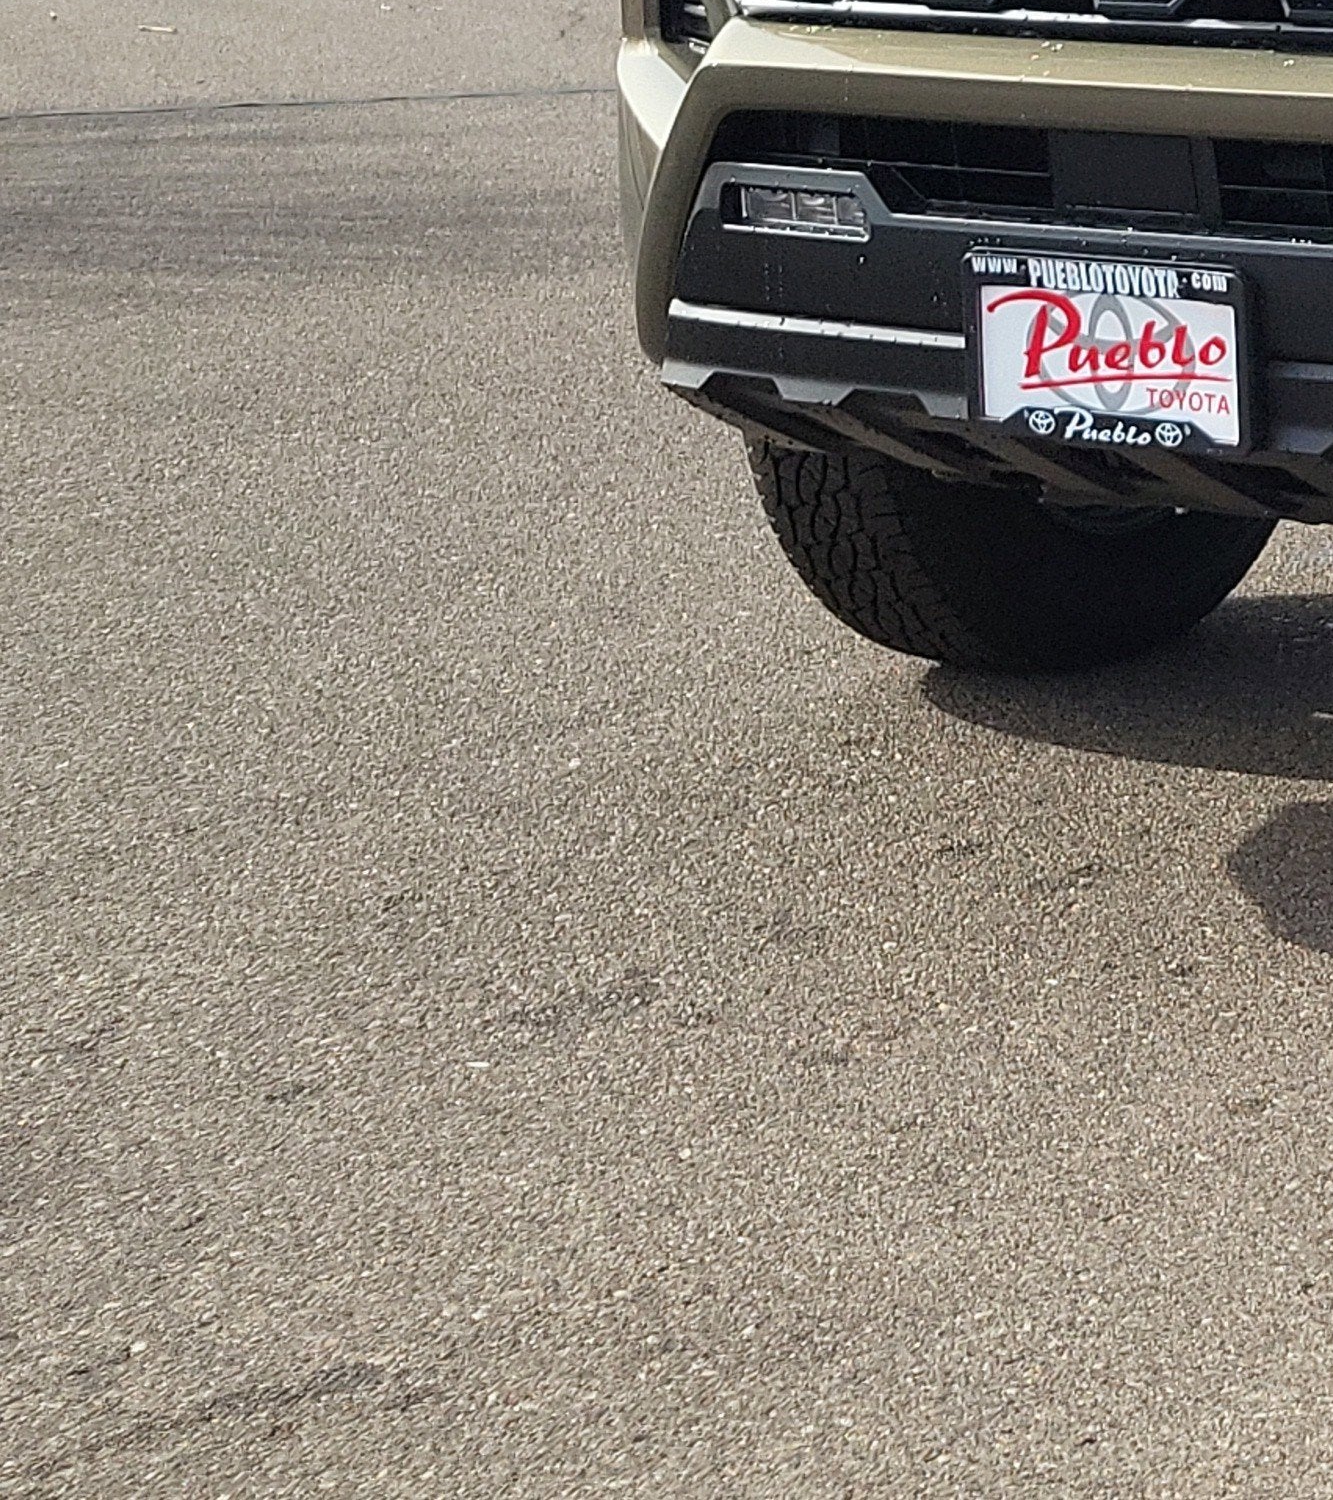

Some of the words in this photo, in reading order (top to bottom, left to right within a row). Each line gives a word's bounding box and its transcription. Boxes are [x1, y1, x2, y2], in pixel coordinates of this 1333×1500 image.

[986, 289, 1227, 379] Pueblo
[1146, 388, 1230, 415] TOYOTA
[1053, 406, 1151, 446] Pueblo
